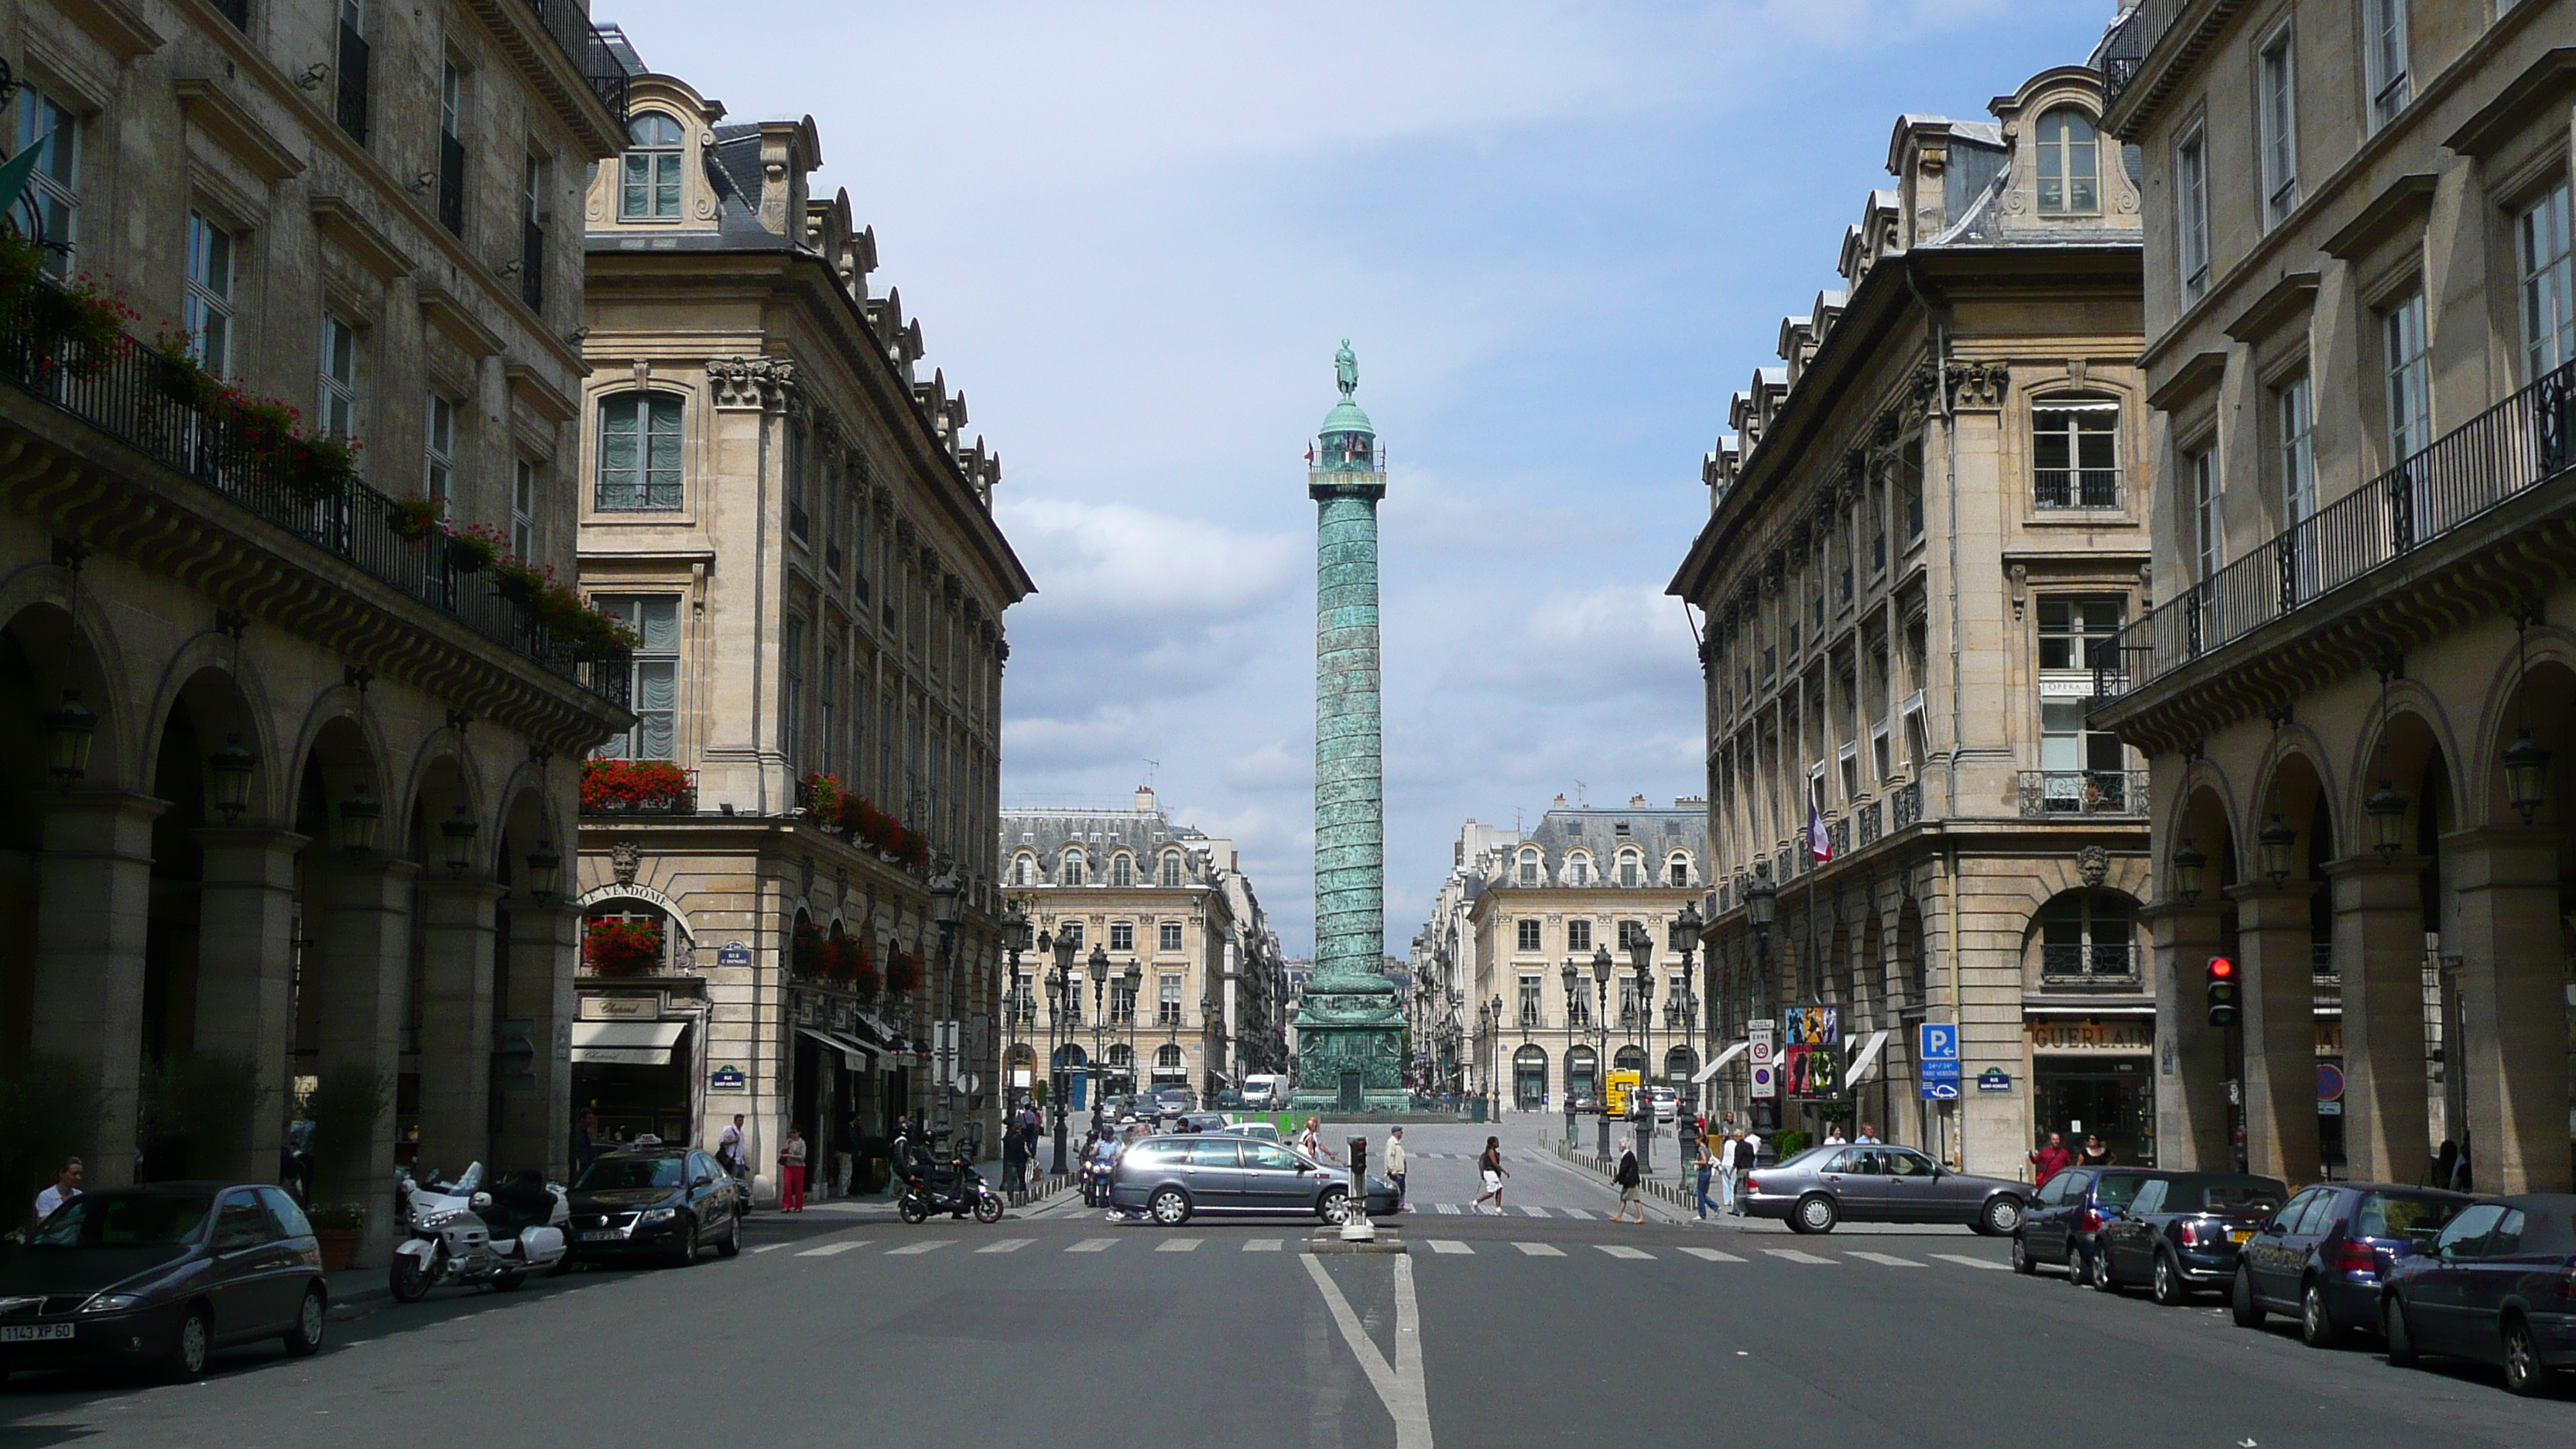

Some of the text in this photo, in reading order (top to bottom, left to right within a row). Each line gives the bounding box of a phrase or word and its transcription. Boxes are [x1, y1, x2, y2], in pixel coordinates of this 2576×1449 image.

[1930, 1030, 1947, 1053] P
[2036, 1028, 2151, 1048] GUERLAIN
[6, 1324, 70, 1340] 1143 XP 60
